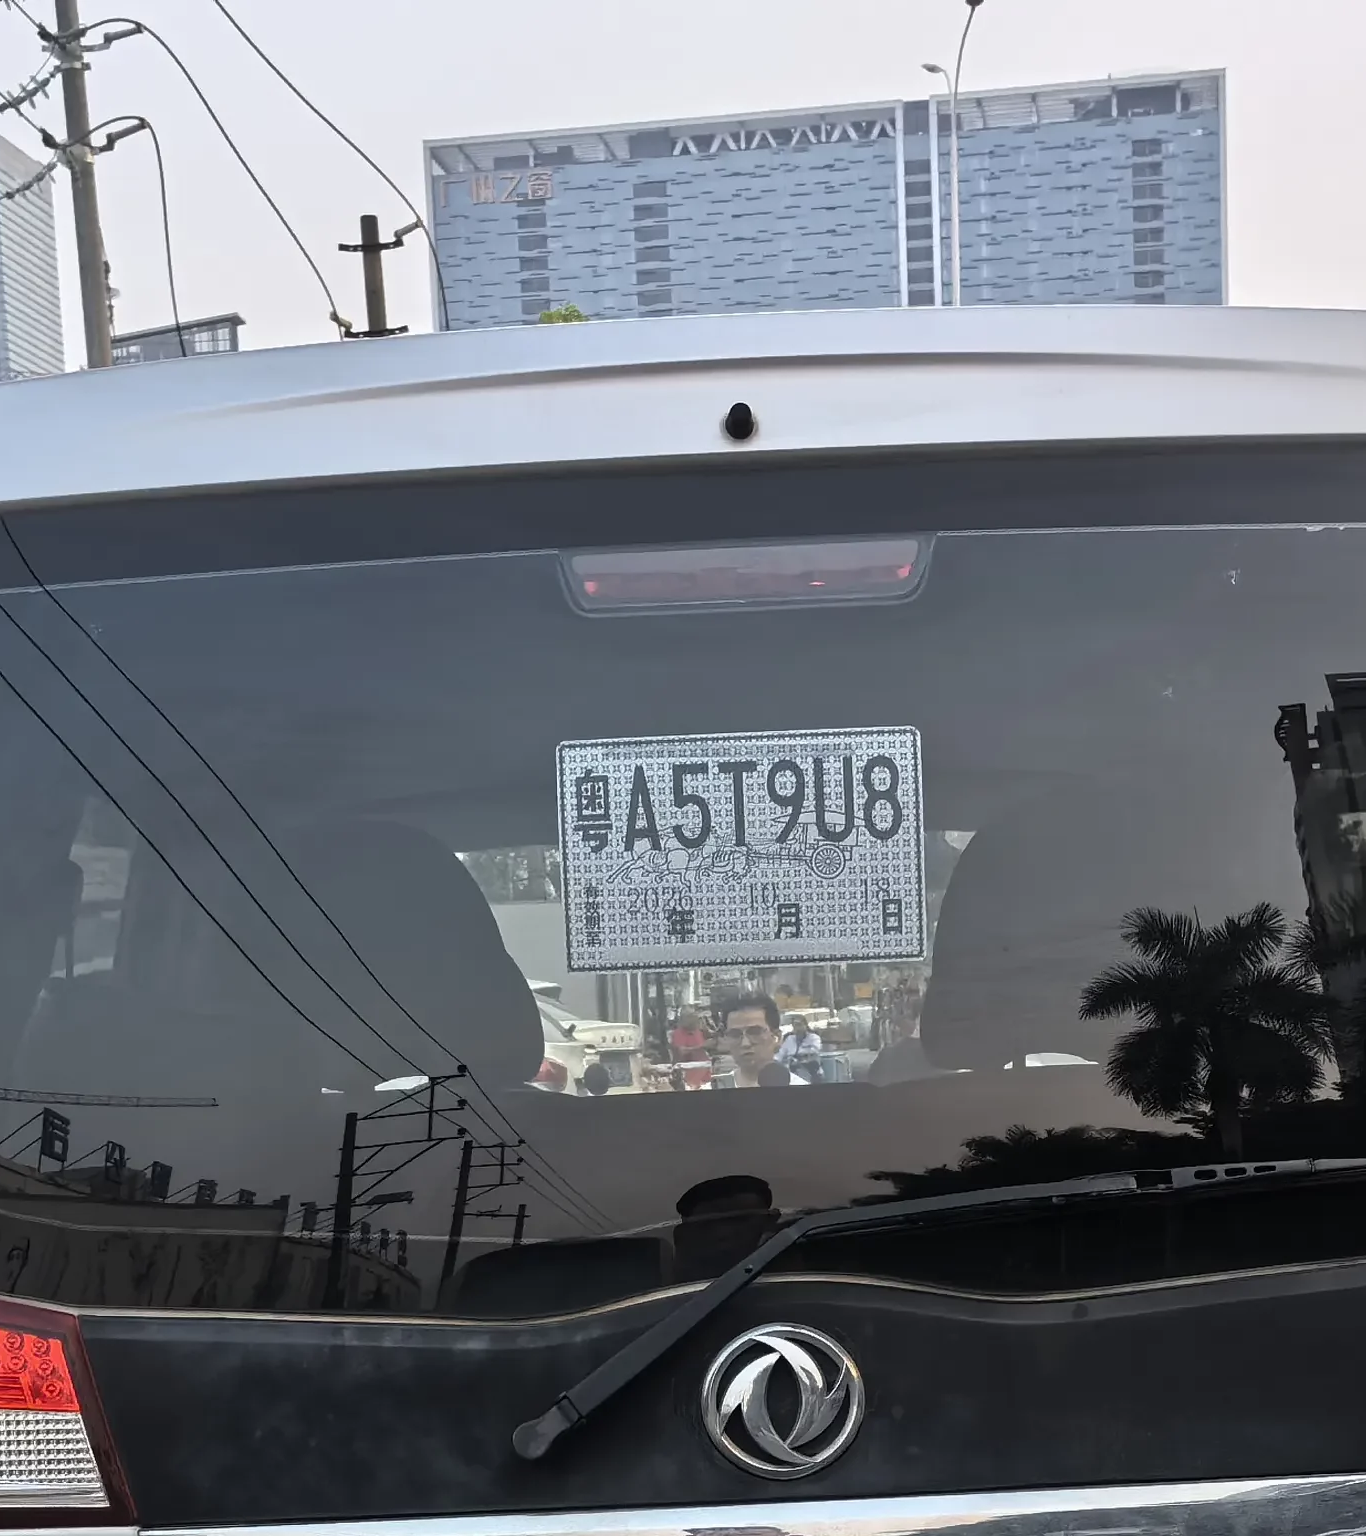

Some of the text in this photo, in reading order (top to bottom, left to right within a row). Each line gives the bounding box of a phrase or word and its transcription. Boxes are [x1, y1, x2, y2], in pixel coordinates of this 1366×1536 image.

[573, 754, 903, 853] 粤A5T9U8
[665, 907, 696, 943] 年
[775, 902, 801, 939] 月
[881, 898, 904, 936] 日
